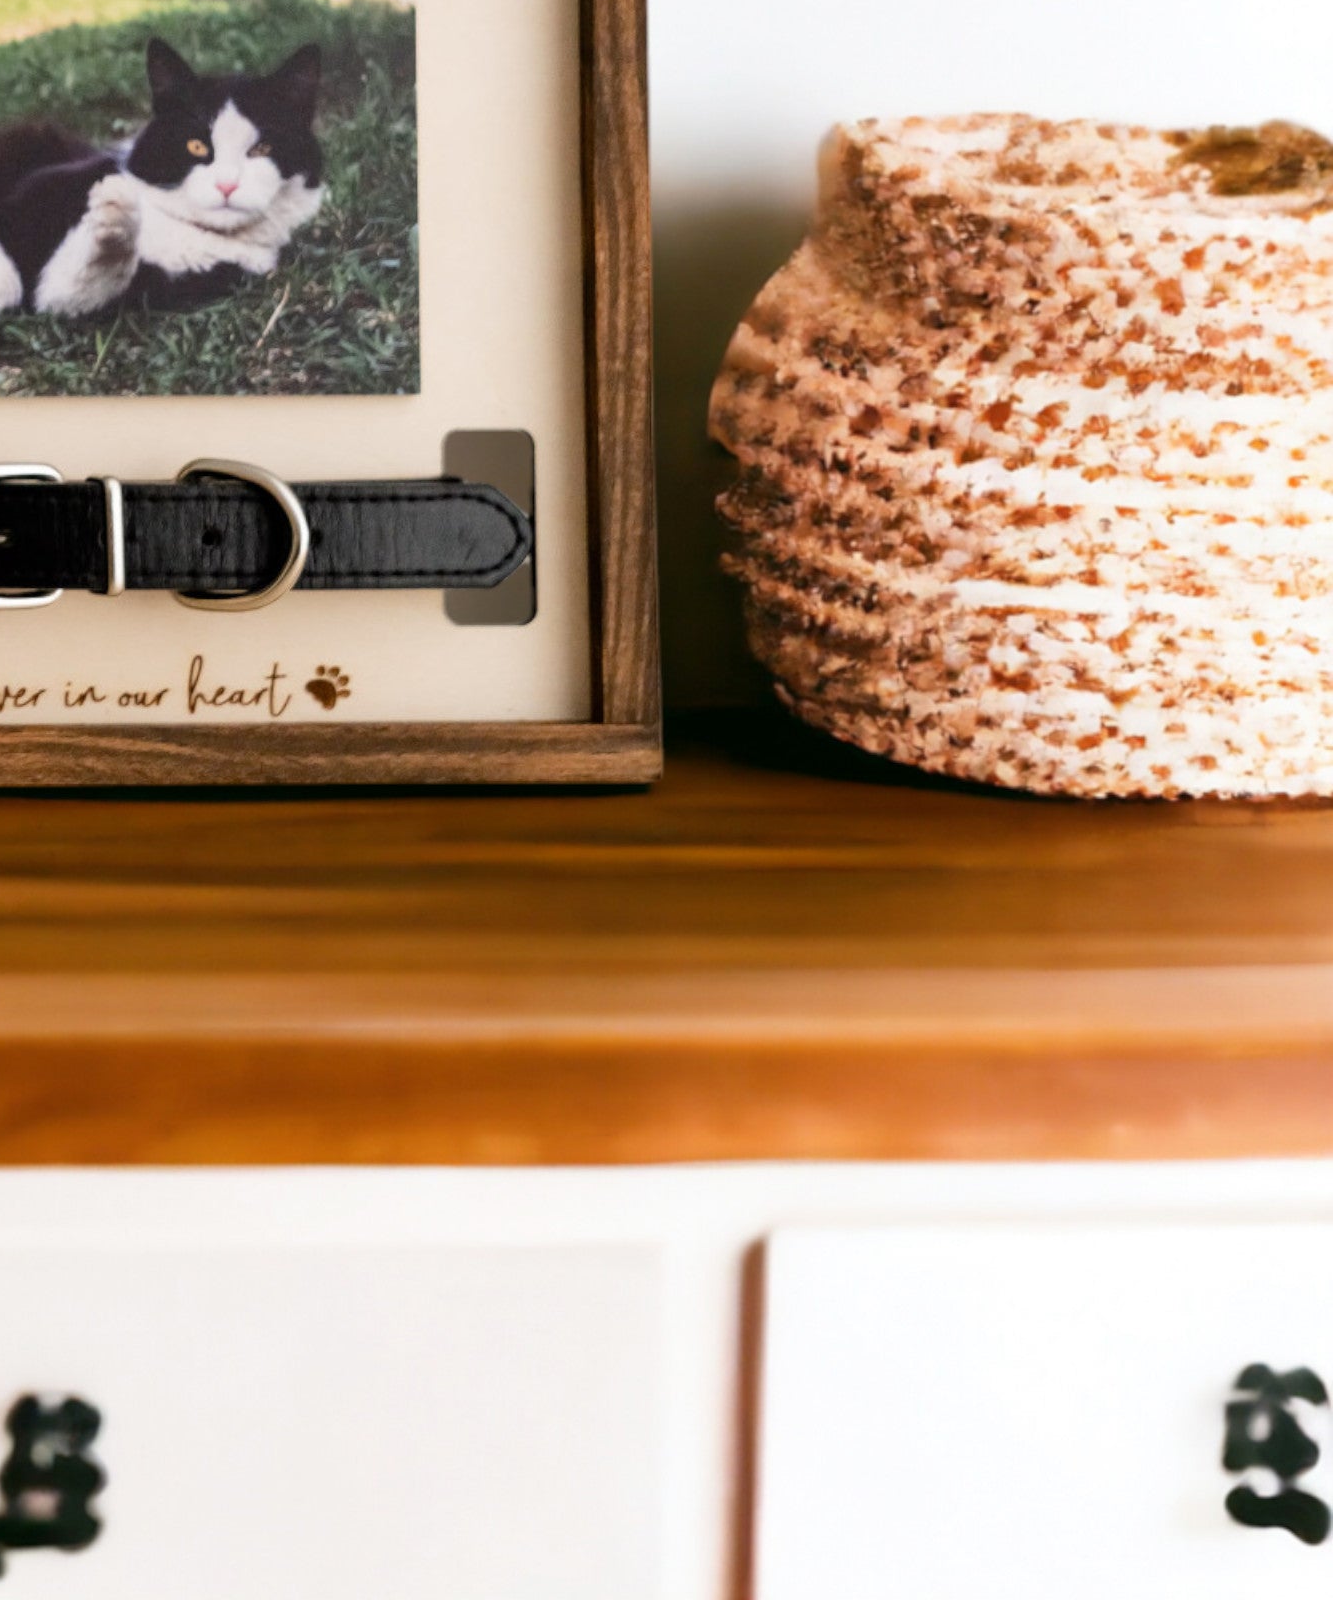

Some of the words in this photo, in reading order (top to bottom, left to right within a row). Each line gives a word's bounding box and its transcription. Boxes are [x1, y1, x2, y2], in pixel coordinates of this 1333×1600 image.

[62, 680, 107, 709] in
[116, 687, 171, 710] our
[187, 653, 293, 718] heart
